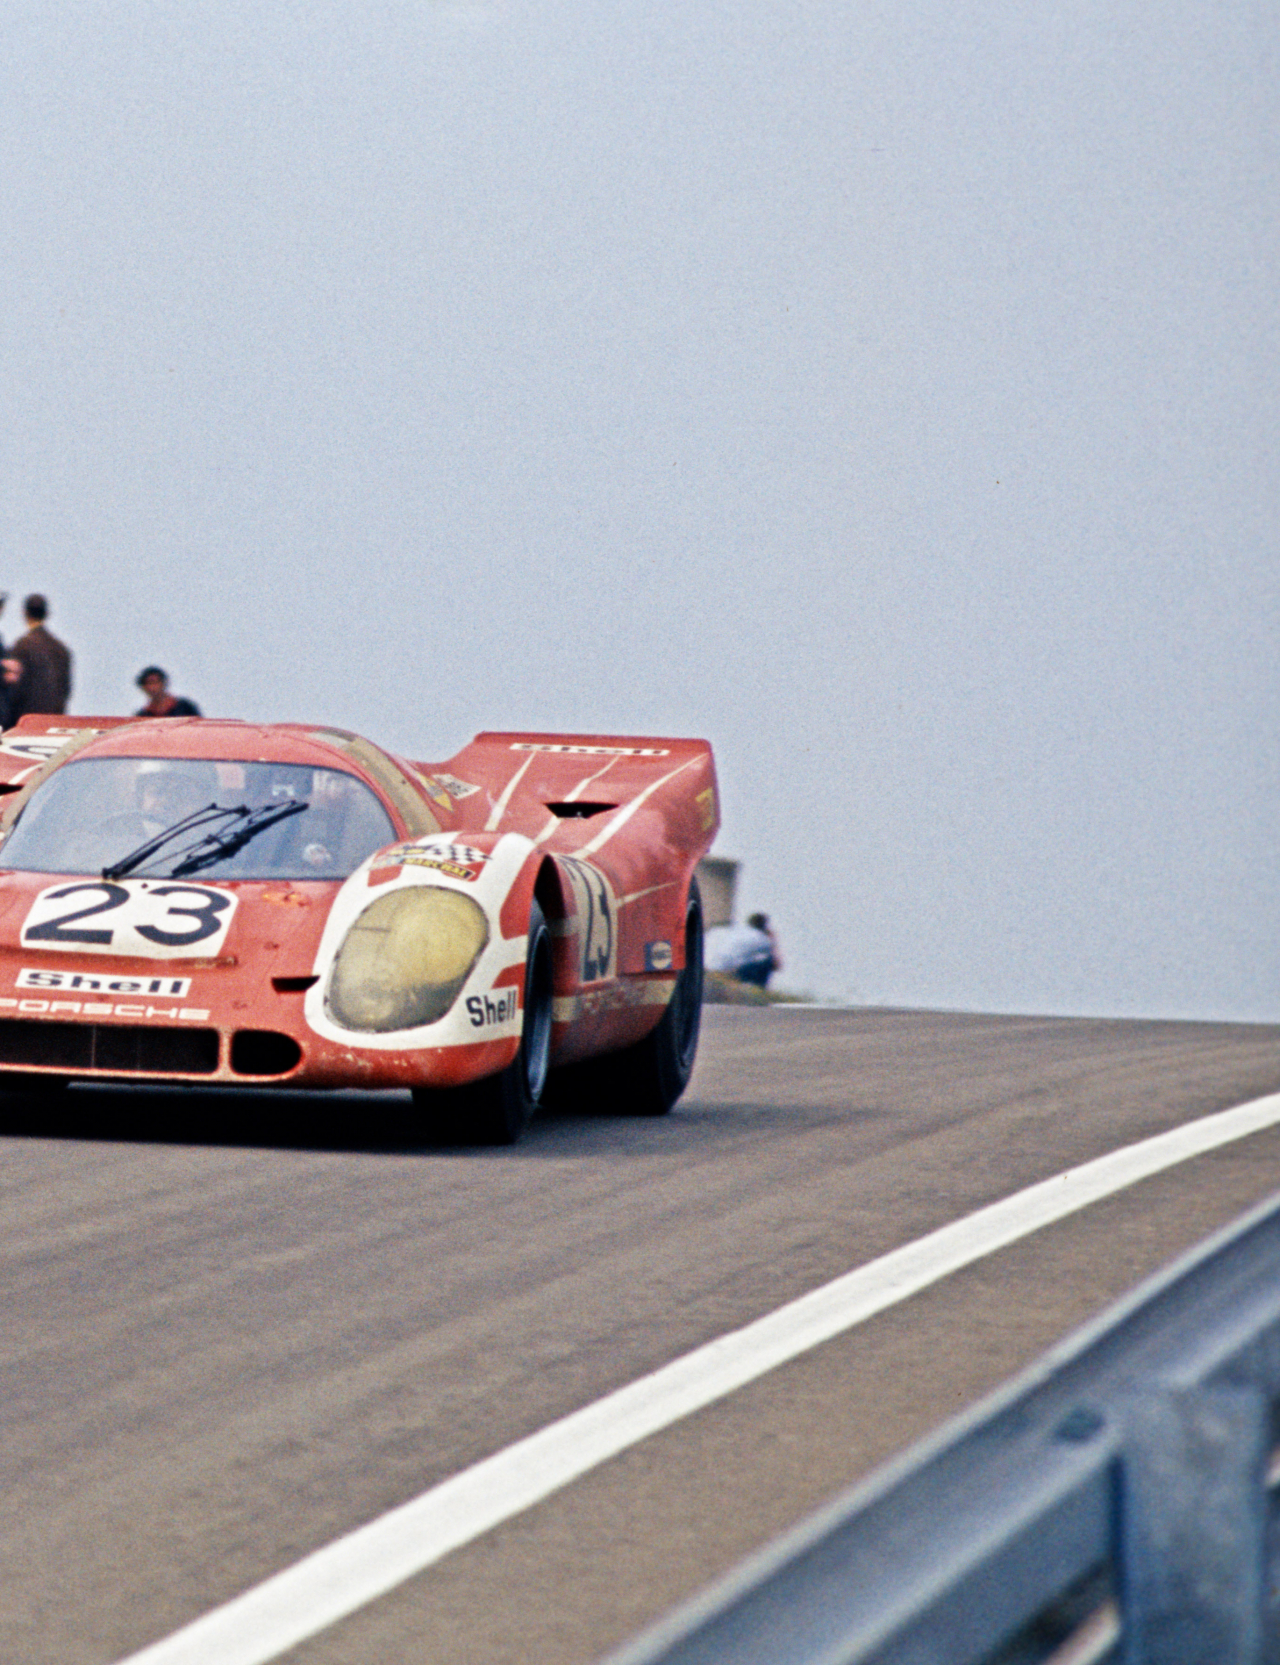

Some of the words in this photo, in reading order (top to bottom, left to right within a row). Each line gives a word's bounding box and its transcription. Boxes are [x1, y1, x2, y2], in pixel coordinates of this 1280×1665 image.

[24, 882, 231, 946] 23
[25, 971, 184, 995] Shell
[465, 988, 518, 1028] Shell
